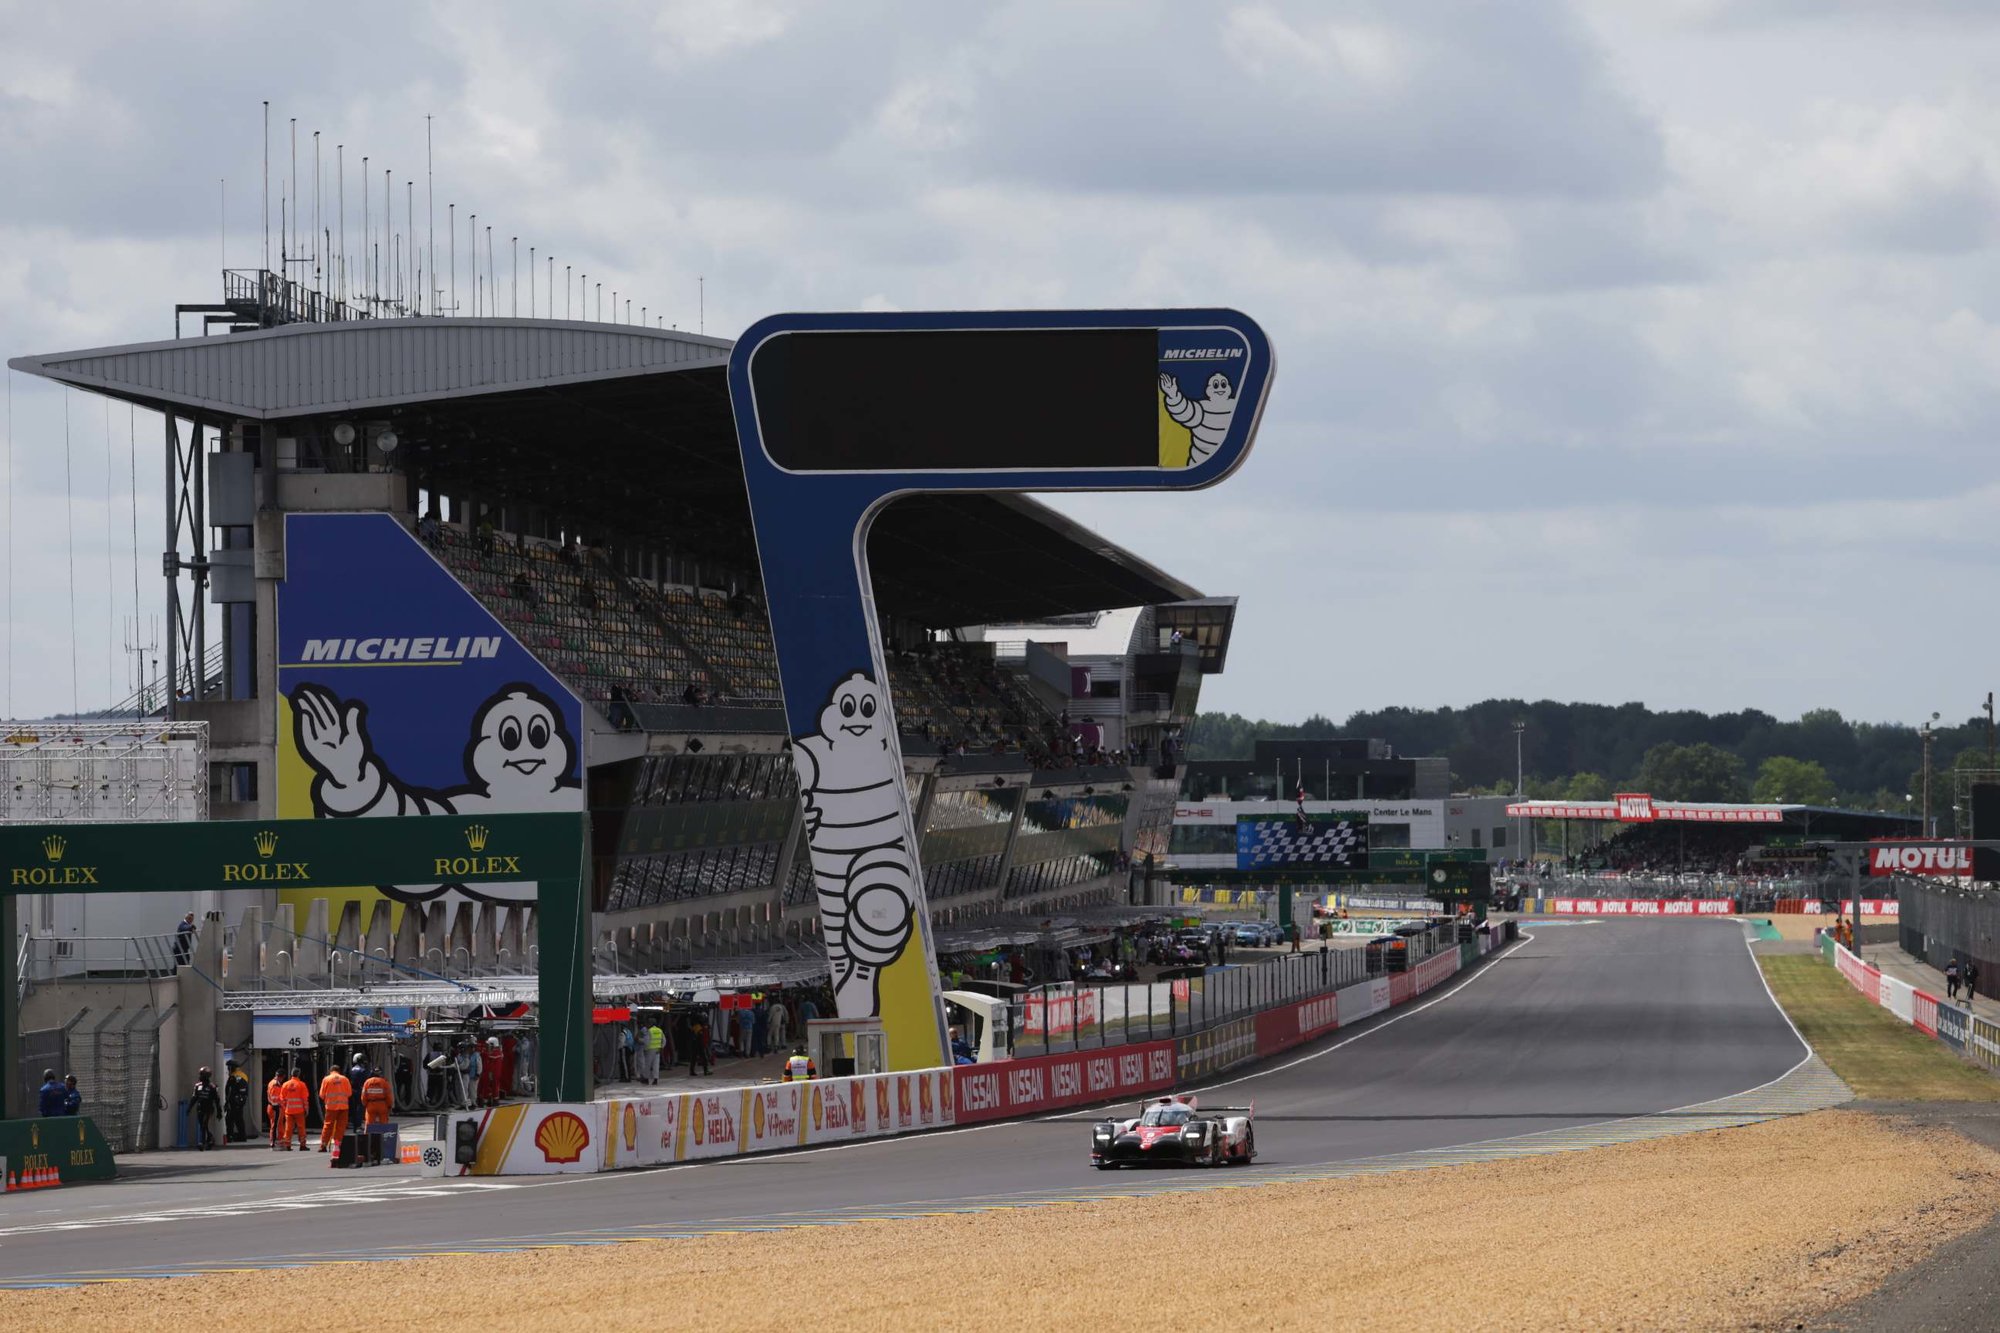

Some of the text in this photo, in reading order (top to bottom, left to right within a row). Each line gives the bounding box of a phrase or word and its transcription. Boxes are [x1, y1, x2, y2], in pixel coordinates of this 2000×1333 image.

[1164, 348, 1243, 359] MICHELIN
[301, 636, 501, 661] MICHELIN
[1374, 808, 1398, 817] Center
[1400, 808, 1410, 816] Le
[1412, 808, 1432, 816] Mans
[1620, 798, 1651, 818] MOTUL
[434, 856, 521, 876] ROLEX
[1875, 847, 1971, 868] MOTUL
[11, 867, 98, 885] ROLEX
[223, 862, 310, 881] ROLEX
[1577, 900, 1597, 913] MOTUL
[1602, 900, 1627, 913] MOTUL
[1631, 900, 1659, 913] MOTUL
[1664, 900, 1693, 913] MOTUL
[1699, 900, 1729, 913] MOTUL
[1845, 902, 1875, 914] MTUL
[288, 1037, 301, 1047] 45
[962, 1072, 1000, 1112] NISSAN
[1008, 1067, 1044, 1105] NISSAN
[1051, 1062, 1081, 1099] NISSAN
[1087, 1057, 1114, 1093] NISSAN
[1119, 1052, 1144, 1087] NISSAN
[1148, 1048, 1172, 1082] NISSAN
[707, 1096, 720, 1115] Shell
[766, 1090, 778, 1109] Shell
[767, 1113, 796, 1137] V-Power
[825, 1102, 849, 1130] HELIX
[708, 1114, 736, 1144] HELIX
[70, 1148, 95, 1165] ROLEX
